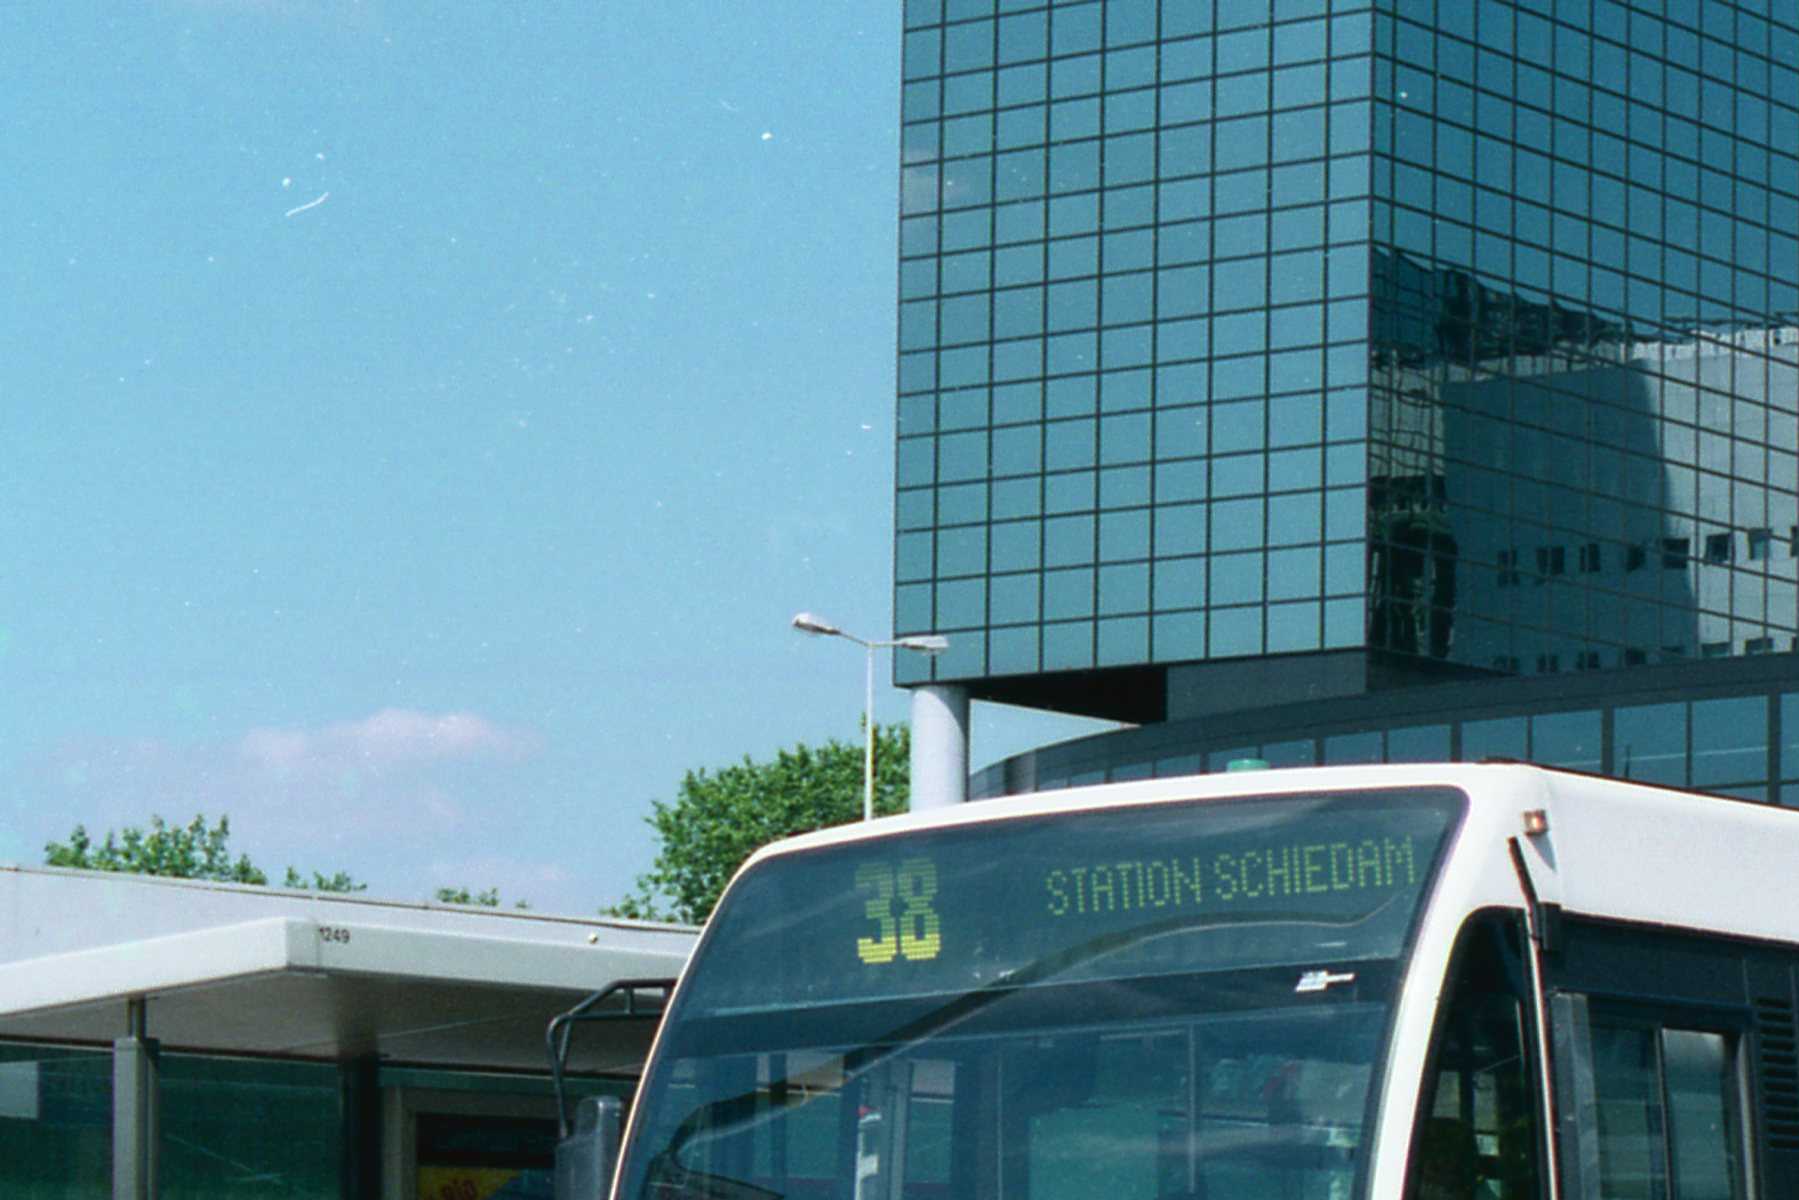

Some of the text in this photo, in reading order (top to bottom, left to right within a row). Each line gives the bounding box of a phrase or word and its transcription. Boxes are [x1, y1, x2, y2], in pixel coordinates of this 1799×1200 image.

[854, 857, 941, 963] 38
[1046, 837, 1416, 915] STATION SCHIEDAM
